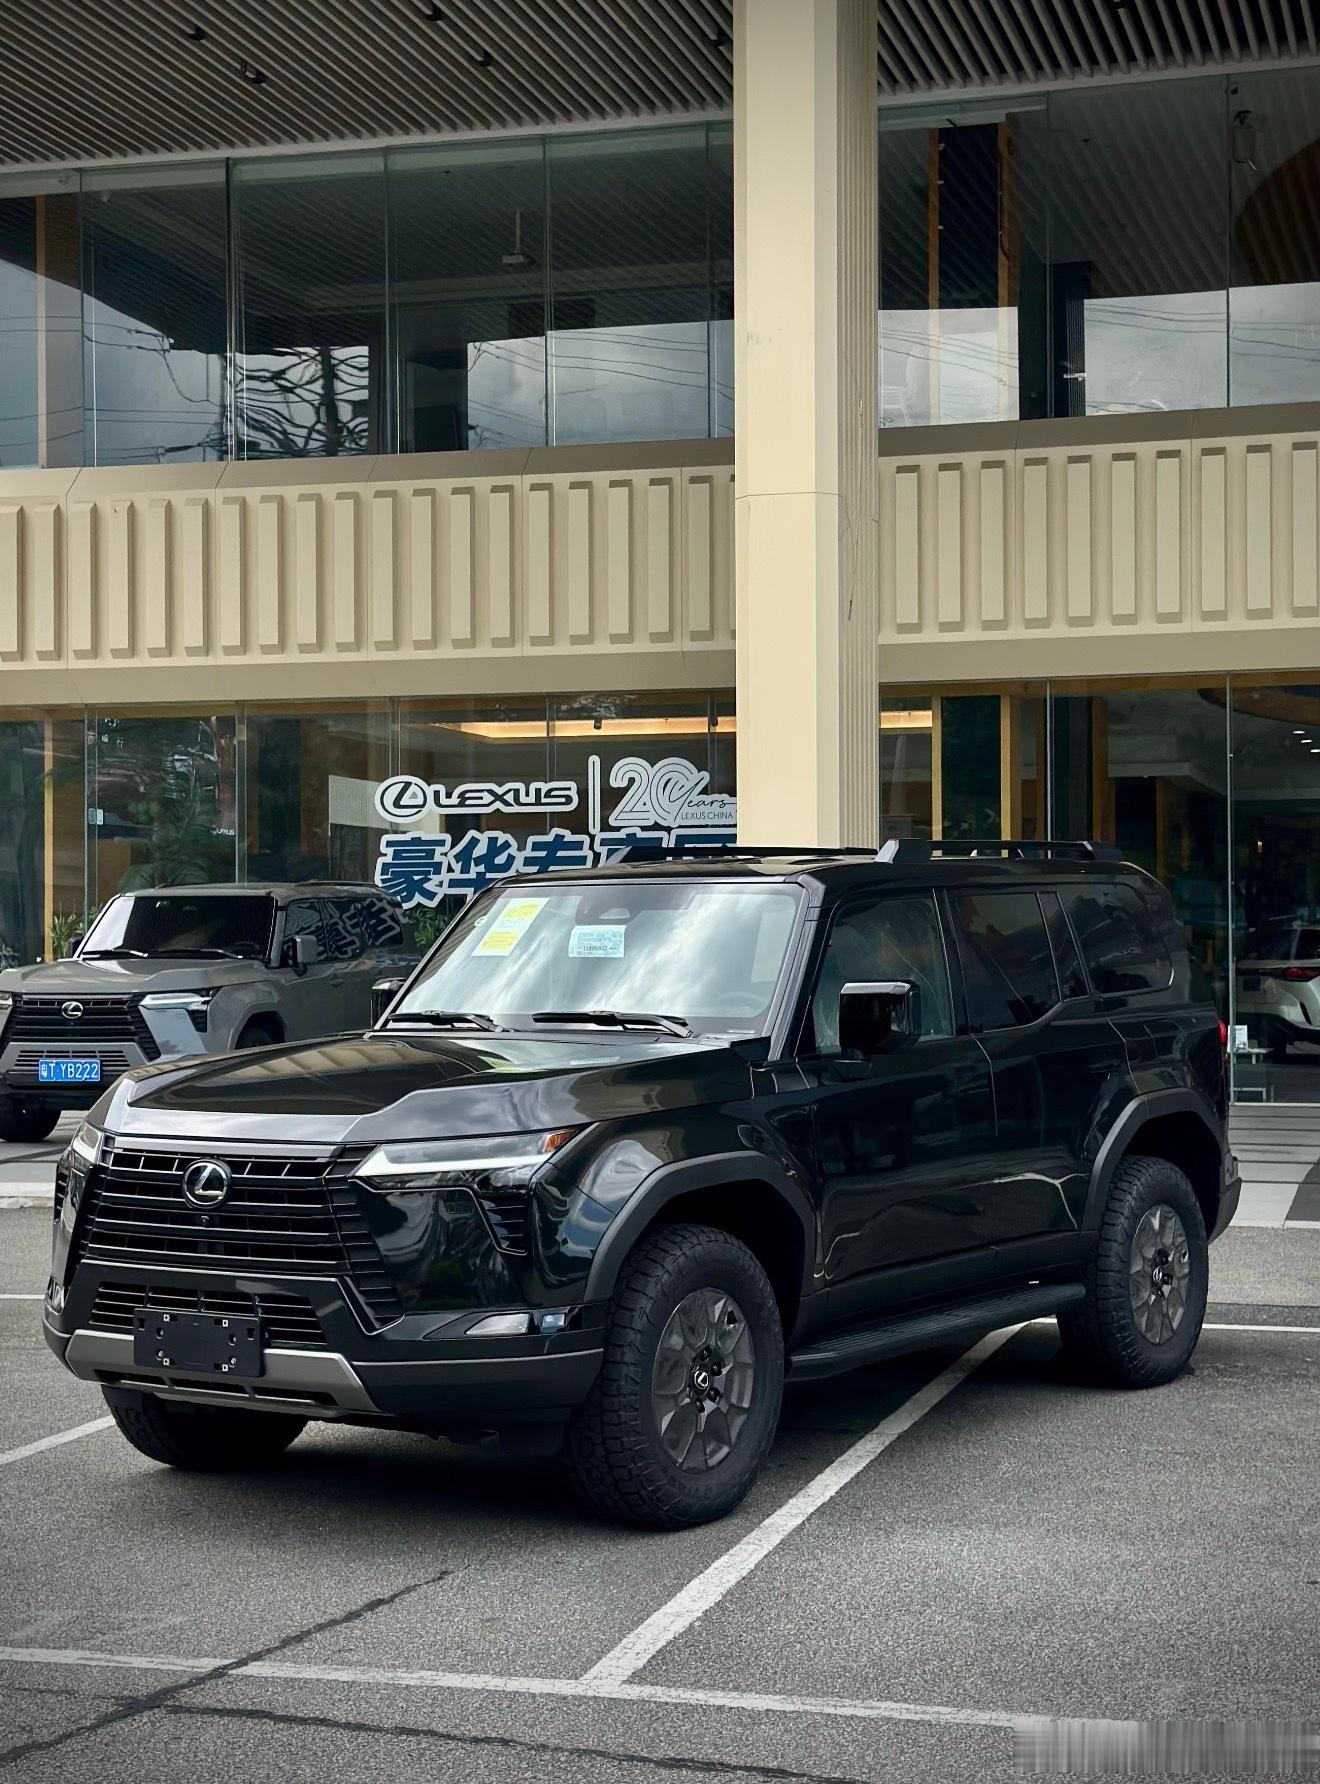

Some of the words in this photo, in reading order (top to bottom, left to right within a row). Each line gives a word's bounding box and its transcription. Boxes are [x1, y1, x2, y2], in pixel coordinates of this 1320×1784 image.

[433, 786, 574, 808] LEXUS
[681, 811, 706, 820] LEXUS
[707, 811, 734, 820] CHINA
